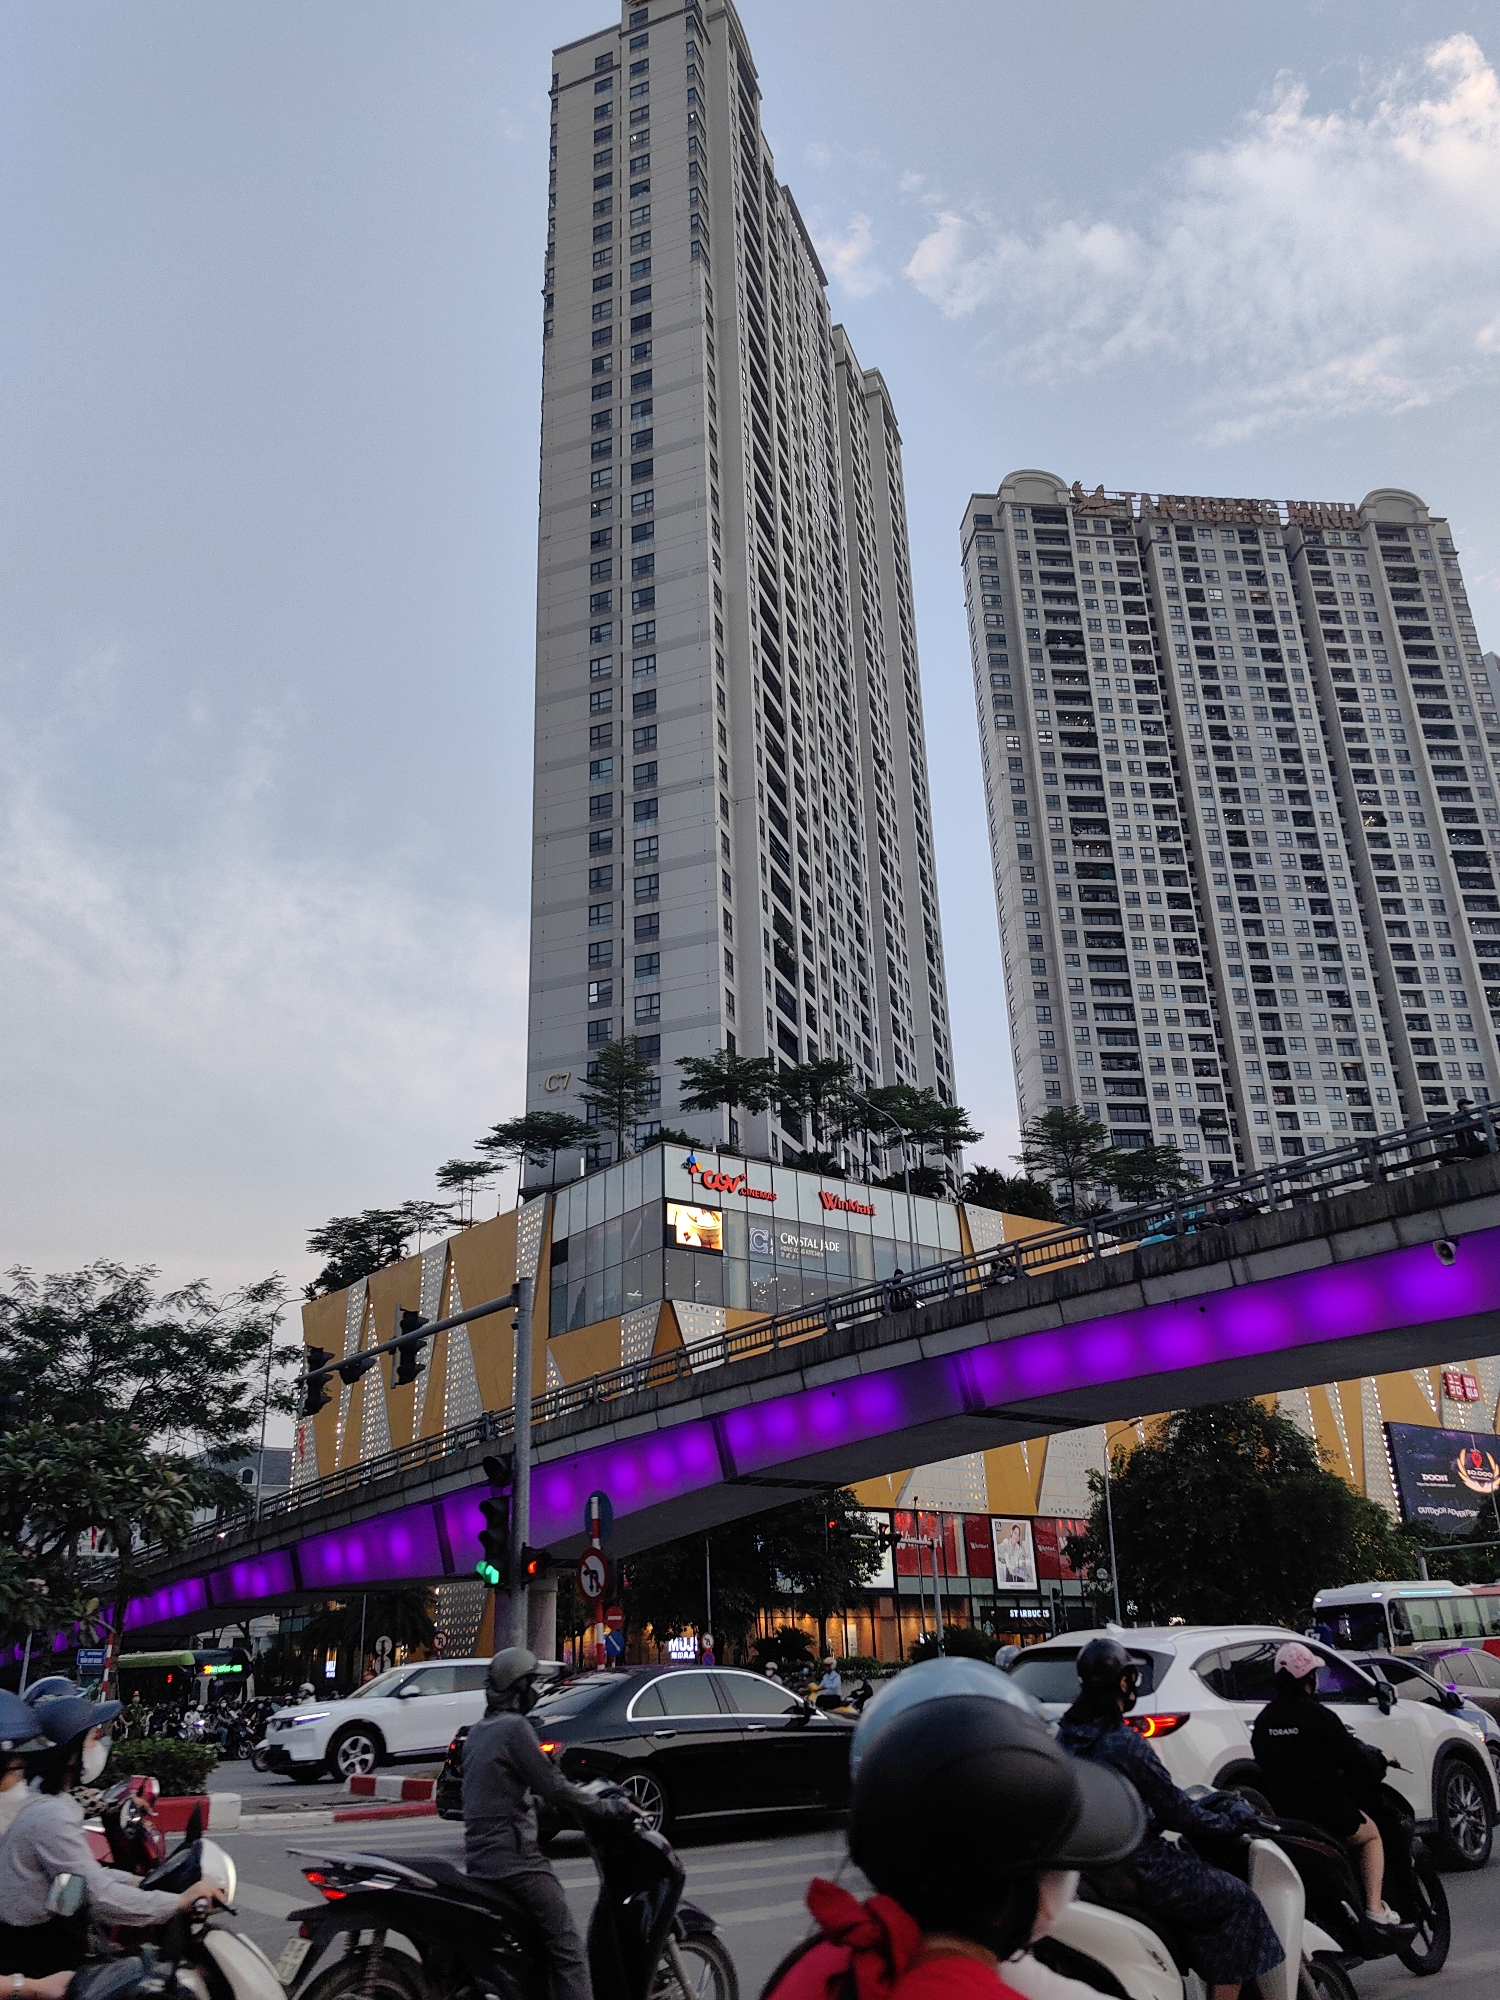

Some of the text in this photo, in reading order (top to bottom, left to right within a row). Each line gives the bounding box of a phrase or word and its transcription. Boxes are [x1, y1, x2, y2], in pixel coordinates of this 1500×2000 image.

[545, 1072, 571, 1092] C7
[702, 1170, 741, 1194] CGV
[740, 1187, 777, 1202] CINEMAS
[819, 1190, 876, 1216] WinMart
[780, 1232, 819, 1249] CRYSTAL
[820, 1239, 840, 1252] JADE
[1417, 1506, 1480, 1518] OUTDOOR ADVERTISIN
